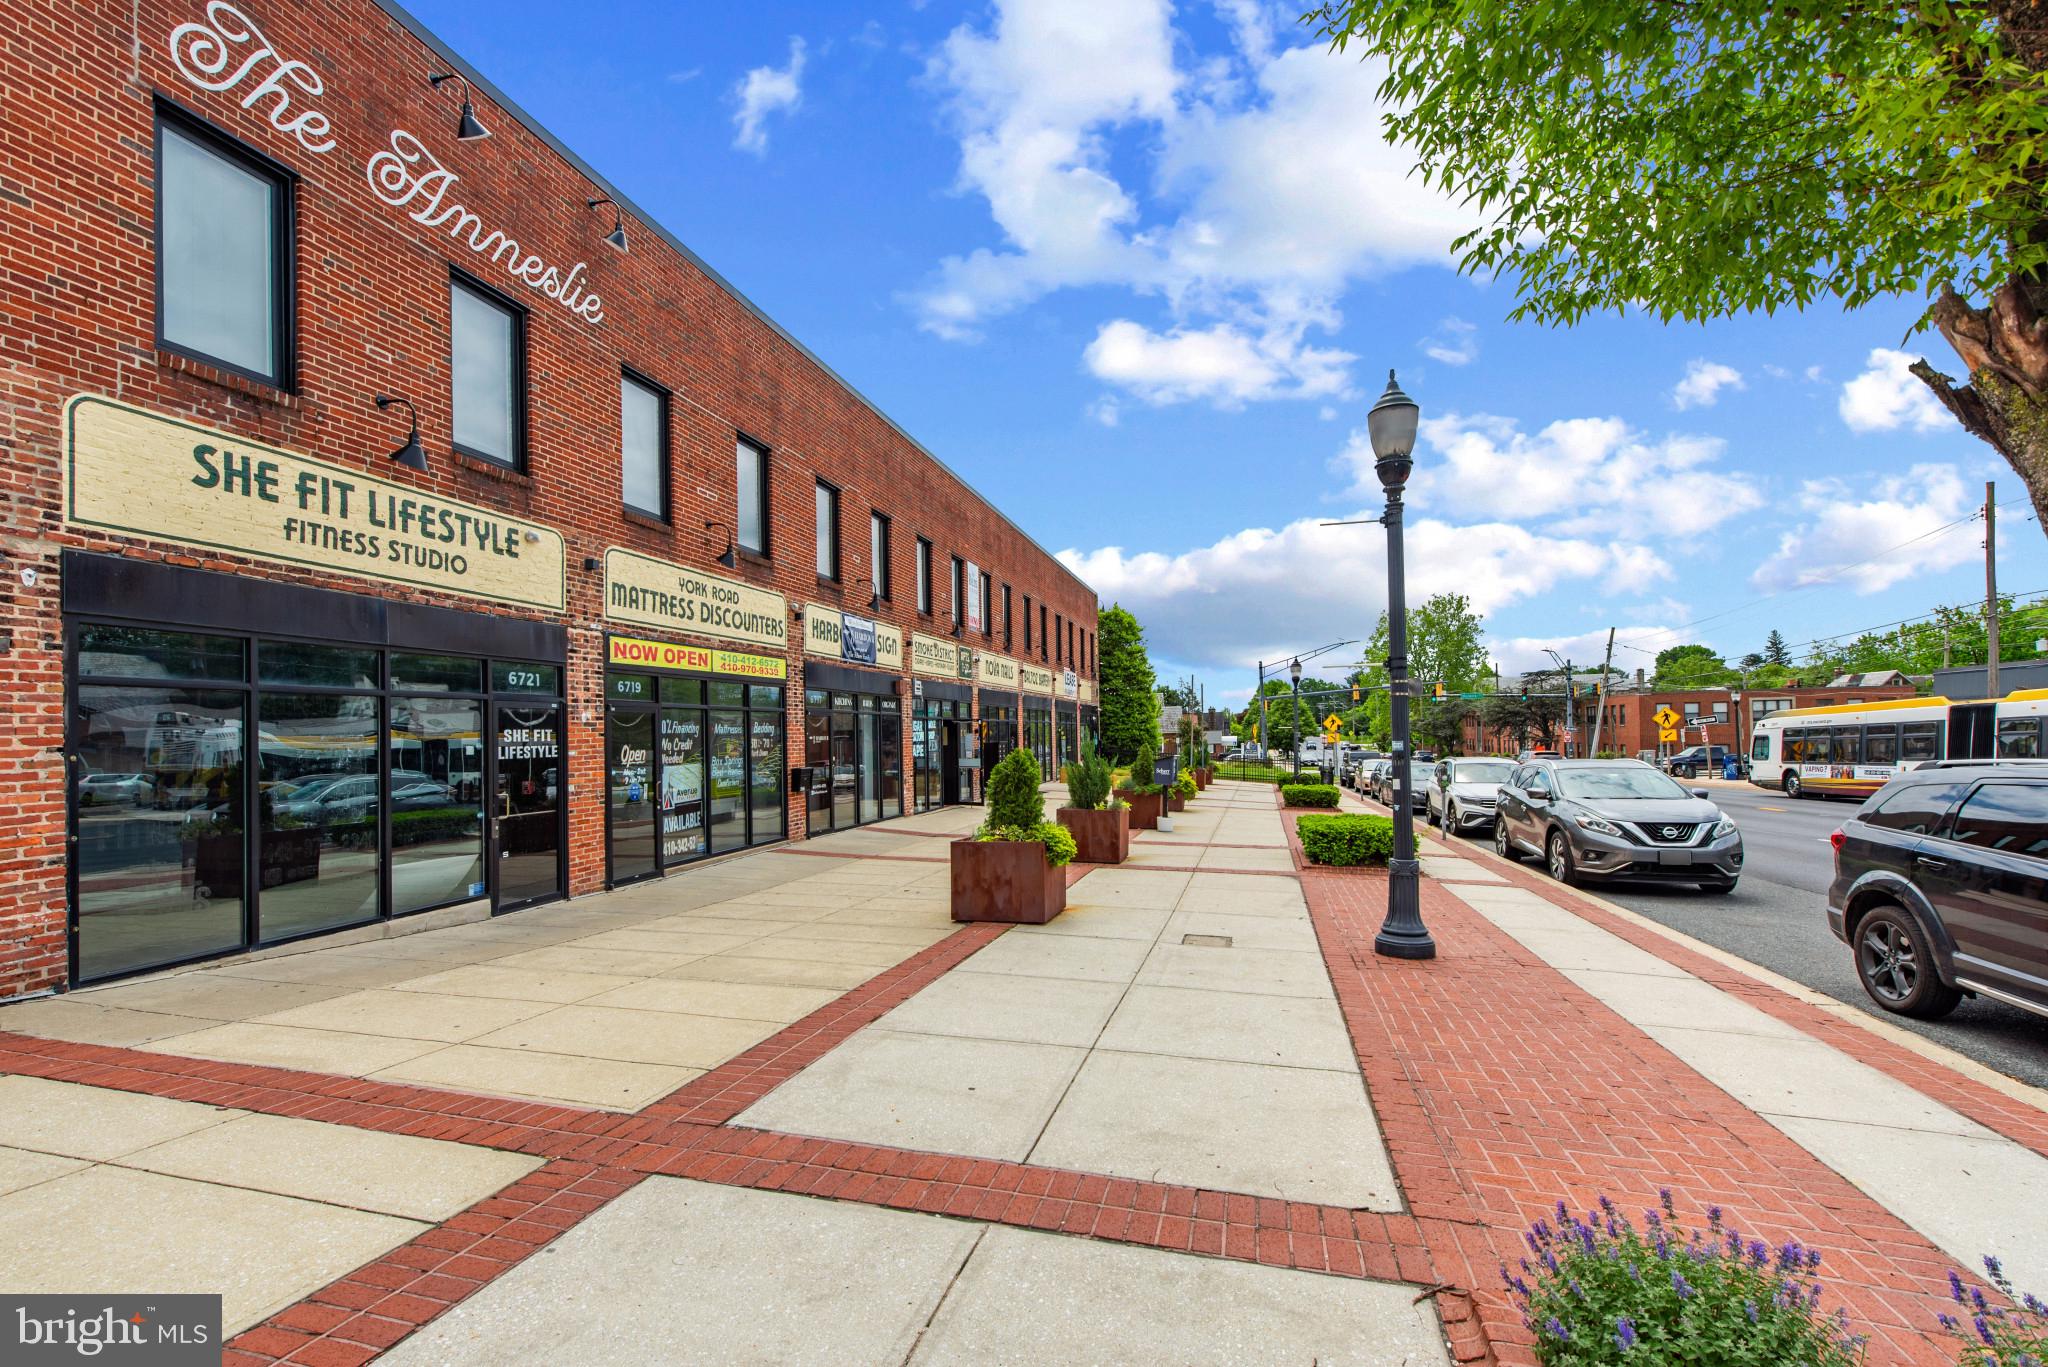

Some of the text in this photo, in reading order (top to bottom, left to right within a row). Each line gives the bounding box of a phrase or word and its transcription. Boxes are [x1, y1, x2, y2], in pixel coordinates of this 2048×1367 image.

[170, 0, 603, 323] The Anneslie
[191, 443, 520, 559] SHE FIT LIFESTYLE
[283, 517, 468, 575] FITNESS STUDIO
[678, 576, 739, 605] YORK ROAD
[611, 581, 784, 638] MATTRESS DISCOUNTERS
[812, 617, 842, 643] HARB
[613, 641, 709, 668] NOW OPEN
[508, 671, 540, 687] 6721
[1001, 663, 1014, 680] NAILS
[617, 680, 641, 693] 6719
[503, 729, 553, 743] SHE FIT
[753, 721, 775, 737] Bedding
[497, 745, 558, 760] LIFESTYLE
[661, 737, 693, 751] No Credit
[621, 744, 646, 768] Open
[1804, 765, 1828, 773] VAPING?
[677, 786, 698, 796] Avenue
[664, 811, 701, 834] AVAILABLE
[663, 835, 698, 856] 410-342-52
